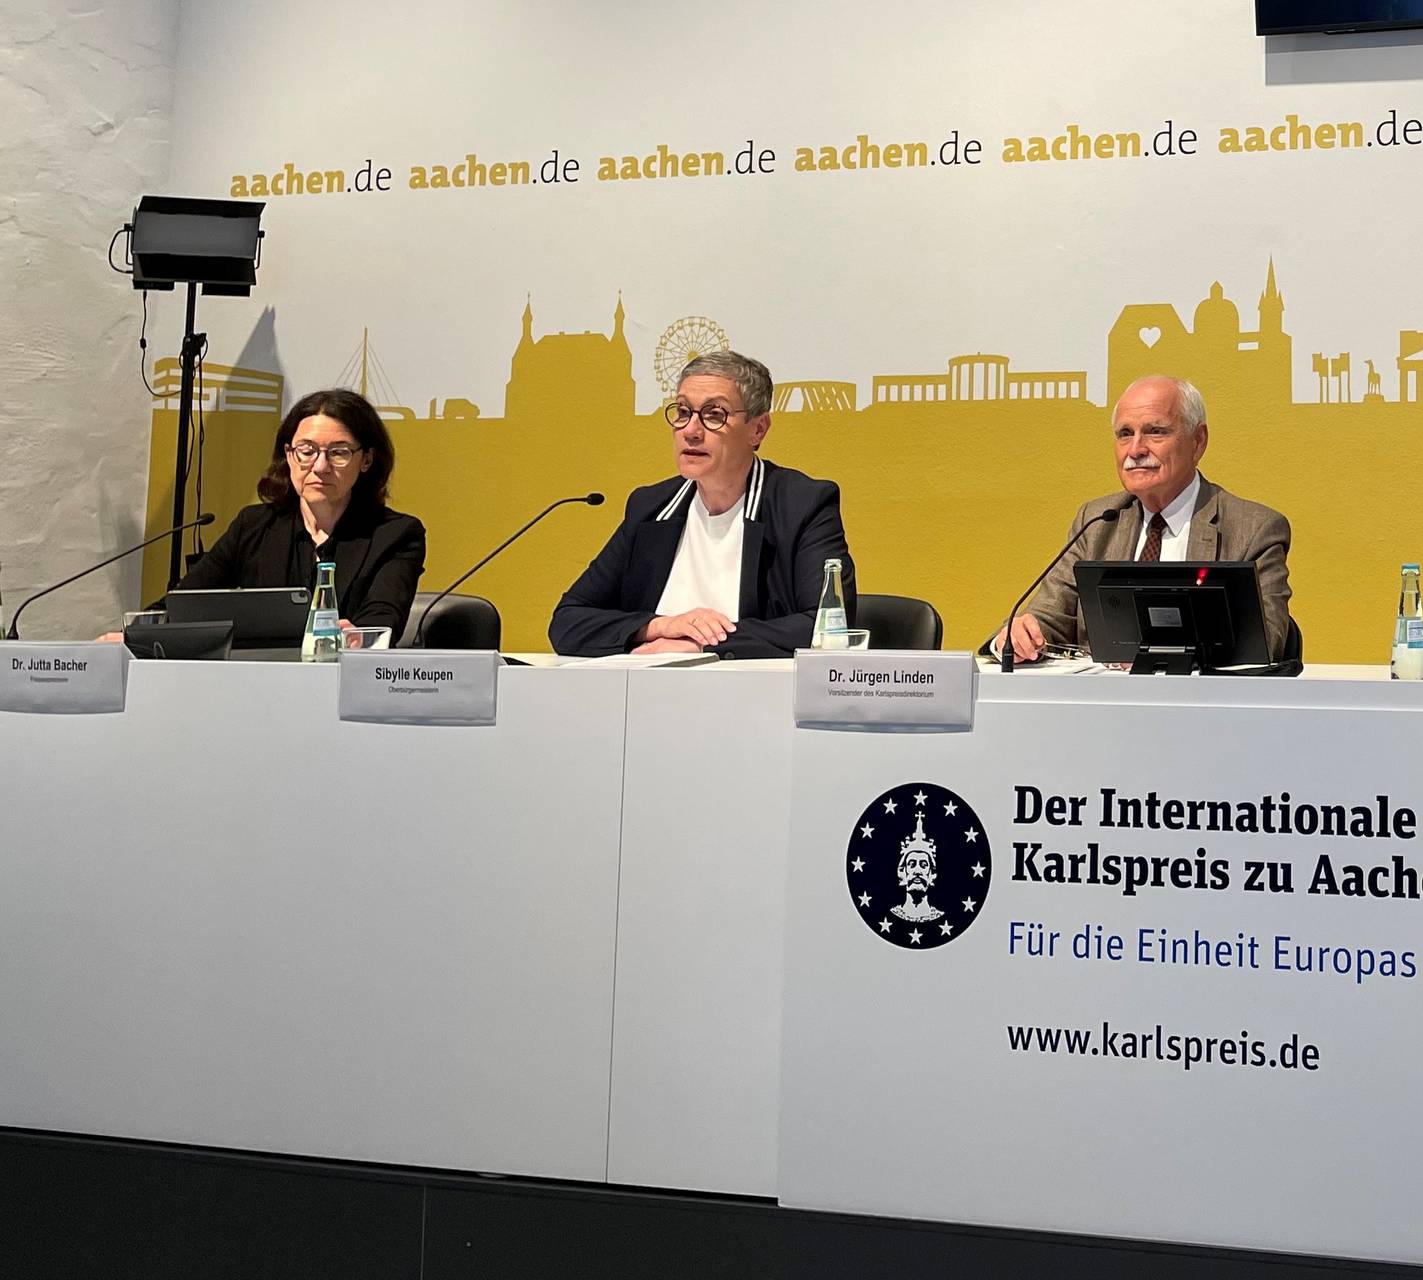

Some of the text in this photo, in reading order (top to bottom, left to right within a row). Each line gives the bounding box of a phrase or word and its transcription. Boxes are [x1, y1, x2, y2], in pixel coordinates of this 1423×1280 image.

[230, 160, 391, 198] aachen.de
[410, 150, 579, 188] aachen.de
[598, 140, 775, 180] aachen.de
[795, 131, 981, 171] aachen.de
[1003, 120, 1197, 162] aachen.de
[1219, 110, 1422, 152] aachen.de
[13, 658, 87, 671] Dr. Jutta Bacher
[376, 668, 452, 683] Sibylle Keupen
[830, 670, 933, 686] Dr. Jürgen Linden
[1014, 786, 1416, 839] Der Internationale
[1012, 843, 1229, 896] Karlspreis
[1244, 862, 1294, 893] zu
[1010, 922, 1416, 984] Für die Einheit Europas
[1008, 1022, 1319, 1070] www.karlspreis.de
